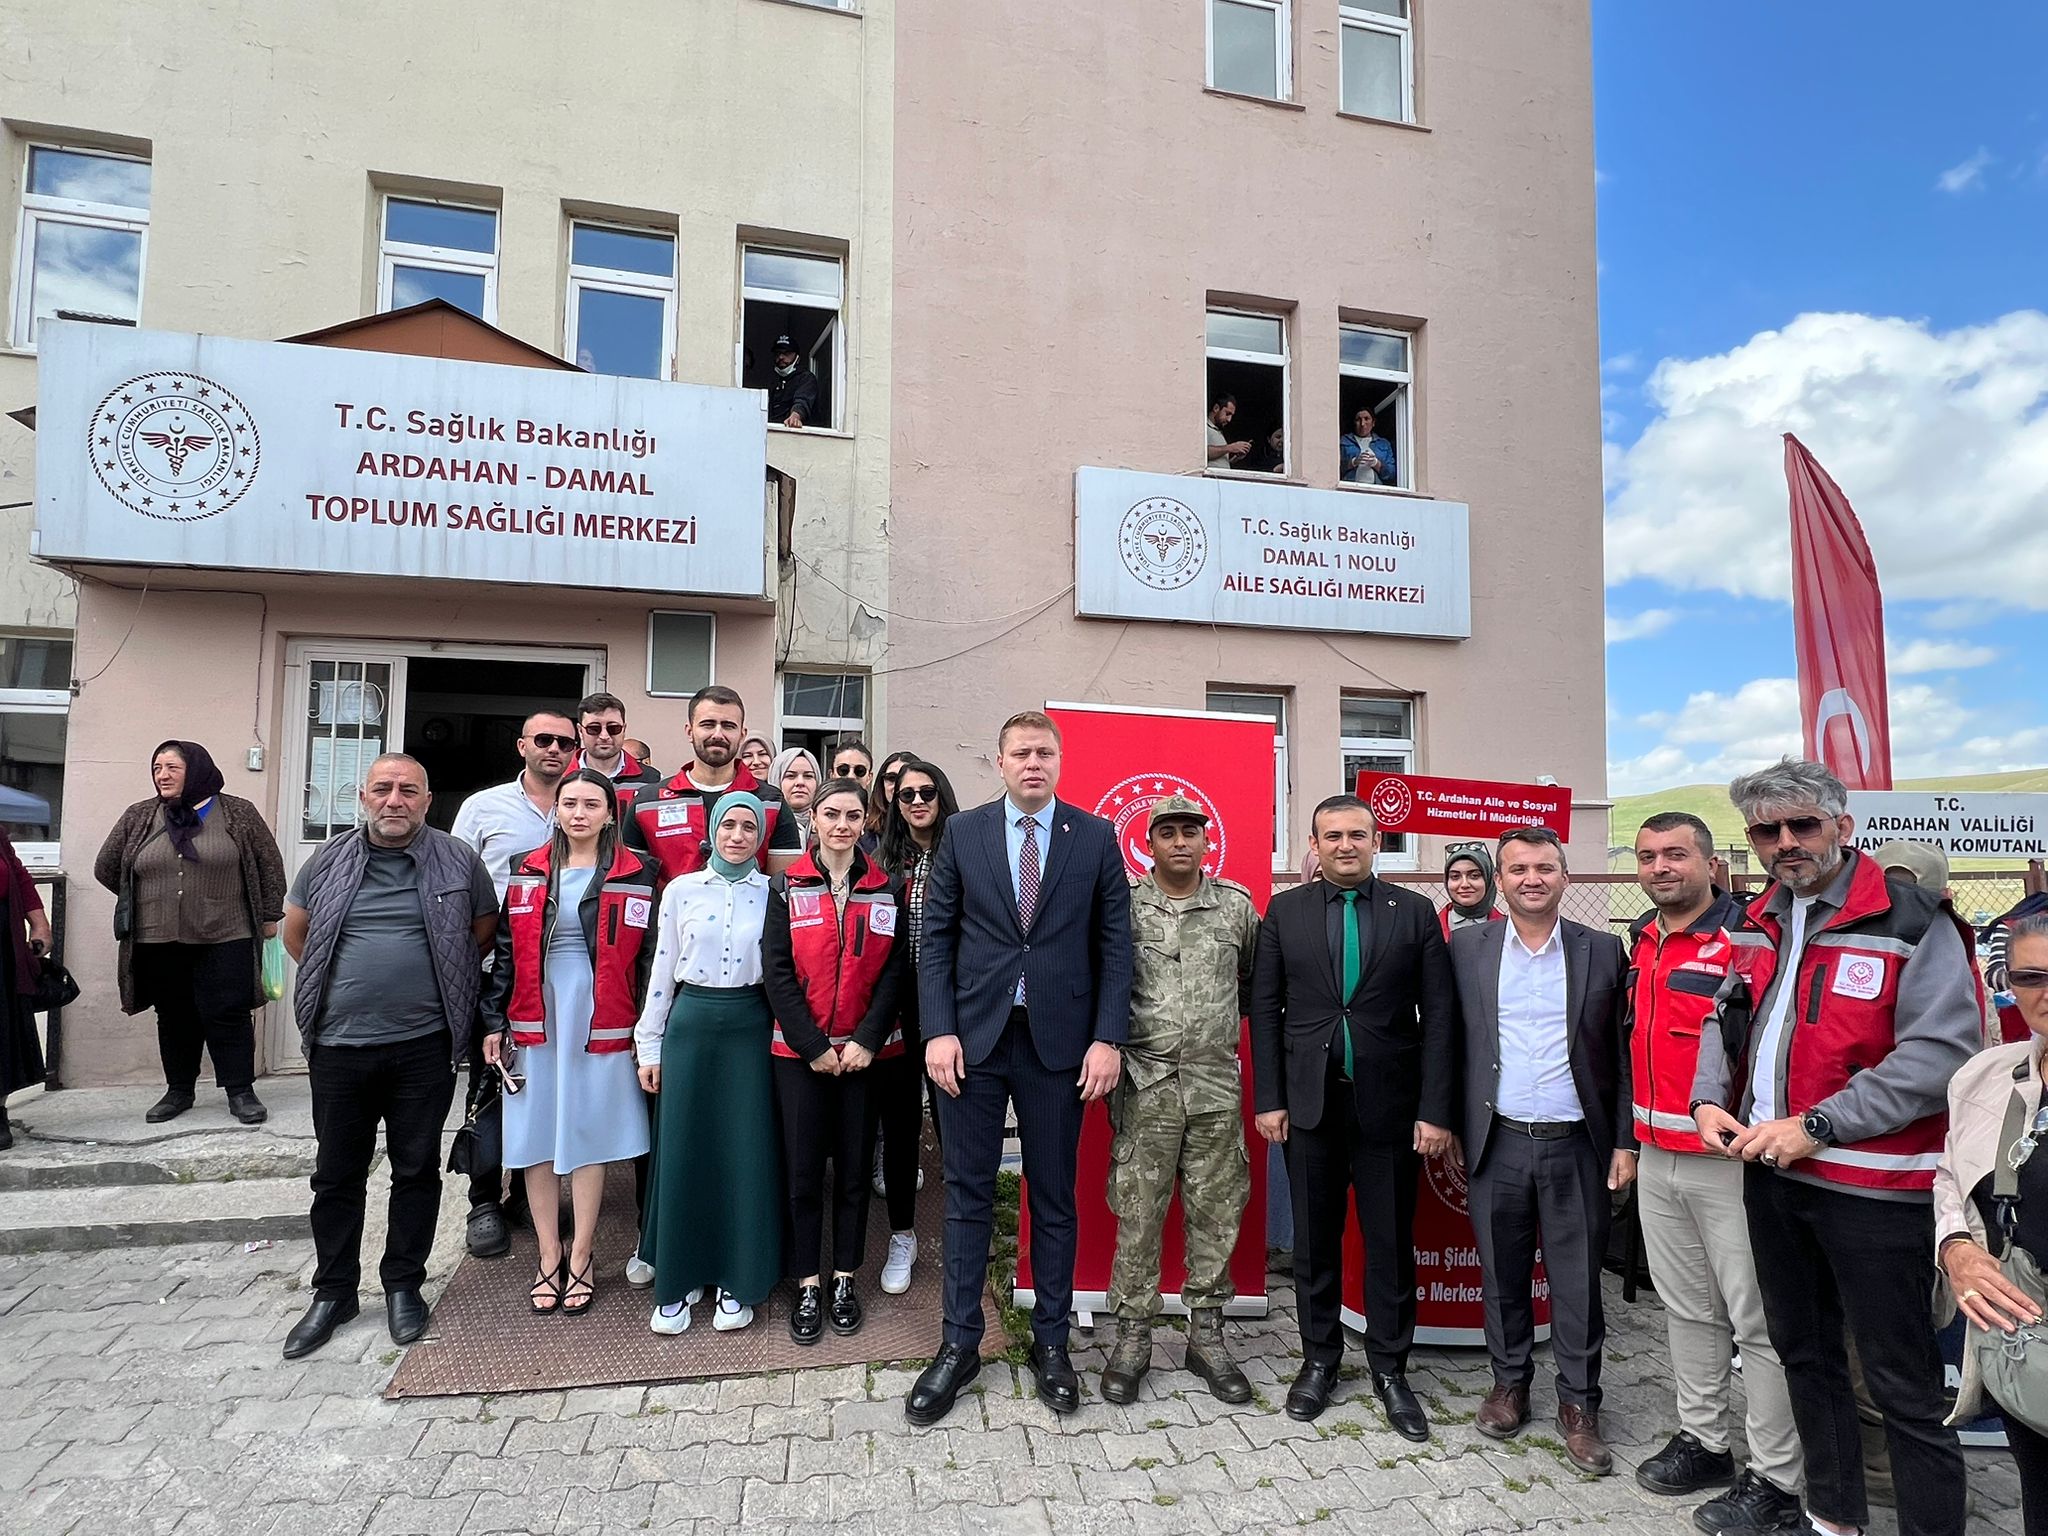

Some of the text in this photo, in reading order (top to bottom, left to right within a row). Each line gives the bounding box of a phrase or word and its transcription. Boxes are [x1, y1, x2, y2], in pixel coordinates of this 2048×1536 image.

[335, 403, 656, 459] T.C. Sağlık Bakanlığı
[356, 451, 518, 486] ARDAHAN
[545, 466, 654, 496] DAMAL
[306, 495, 697, 545] TOPLUM SAĞLIĞI MERKEZİ
[1240, 517, 1415, 550] T.C. Sağlık Bakanlığı
[1263, 548, 1396, 573] DAMAL 1 NOLU
[1223, 574, 1425, 604] AİLE SAĞLIĞI MERKEZİ
[1416, 790, 1557, 813] T.C. Ardahan Aile ve Sosyal
[1934, 797, 1965, 812] T.C.
[1426, 807, 1479, 821] Hizmetler
[1489, 812, 1545, 827] Müdürlüğü
[1866, 815, 2034, 833] ARDAHAN VALİLİĞİ
[1950, 838, 2047, 853] KOMUTANL
